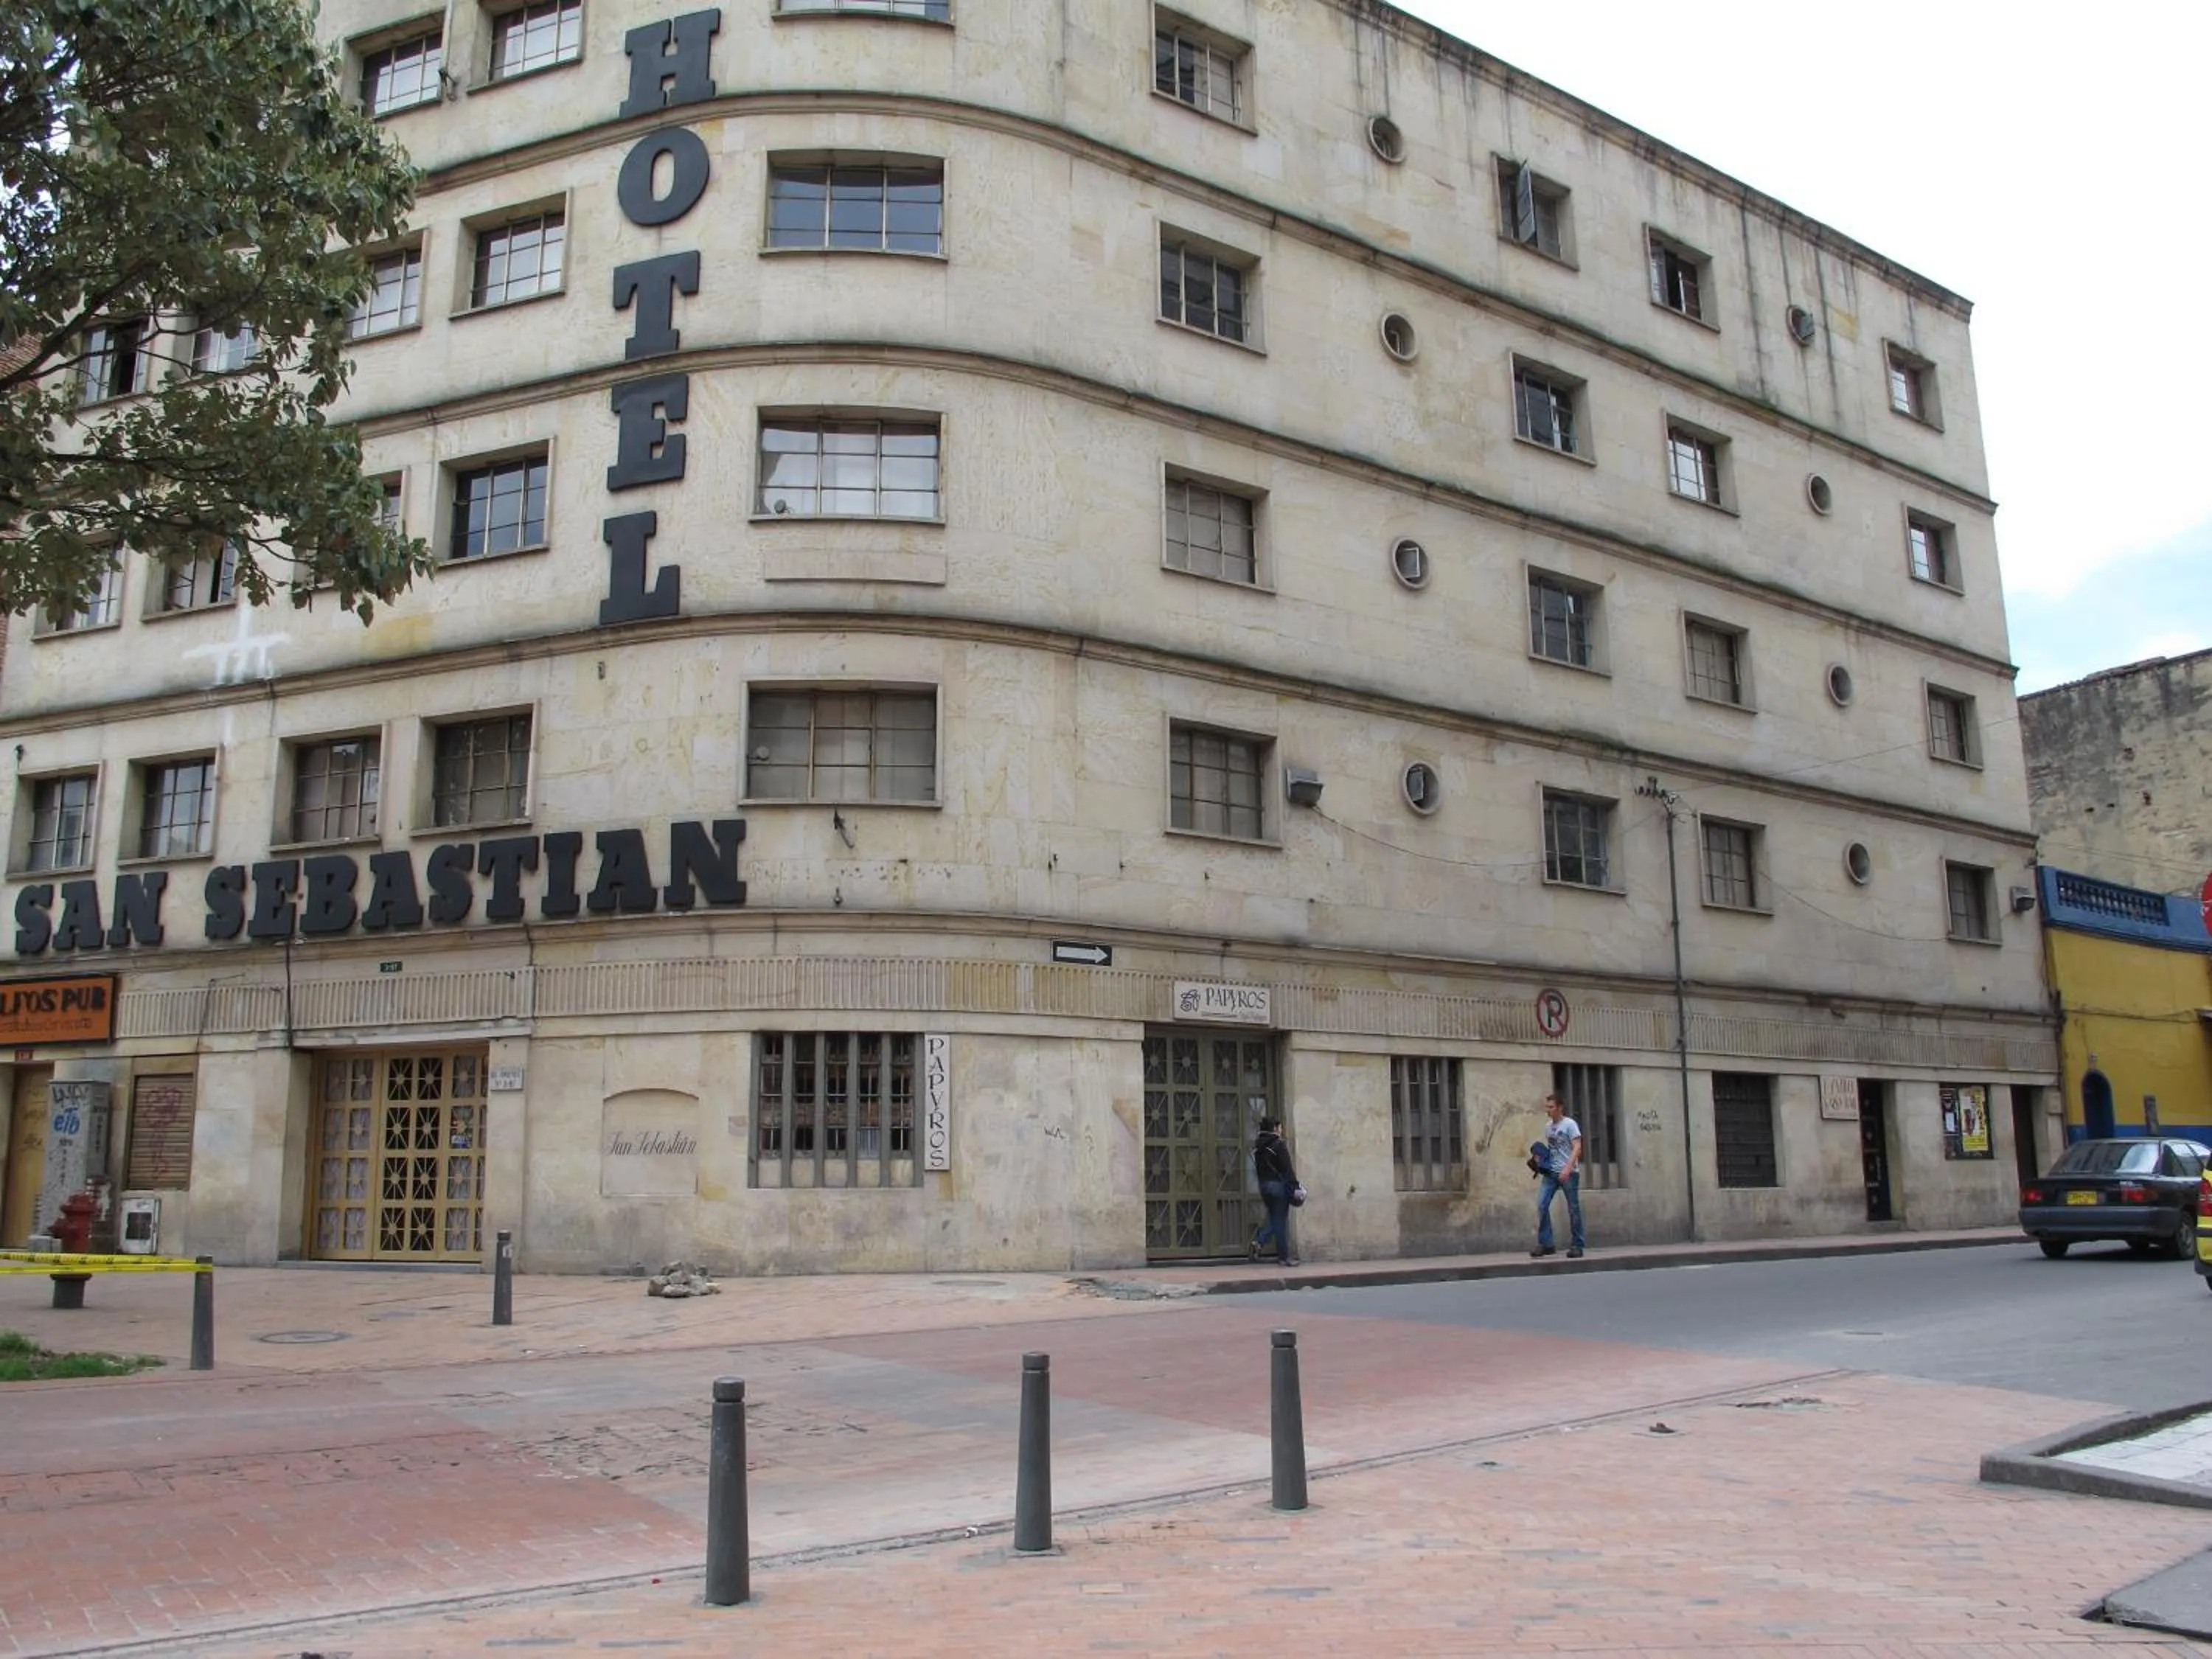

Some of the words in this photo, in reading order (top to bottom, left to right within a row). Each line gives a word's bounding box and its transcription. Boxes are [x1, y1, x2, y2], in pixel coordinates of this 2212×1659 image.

[599, 8, 721, 625] HOTEL
[14, 872, 168, 954] SAN
[204, 818, 748, 940] SEBASTIAN
[60, 985, 105, 1013] PUB
[1205, 987, 1267, 1012] PAPYROS
[928, 1037, 945, 1167] PAPYROS
